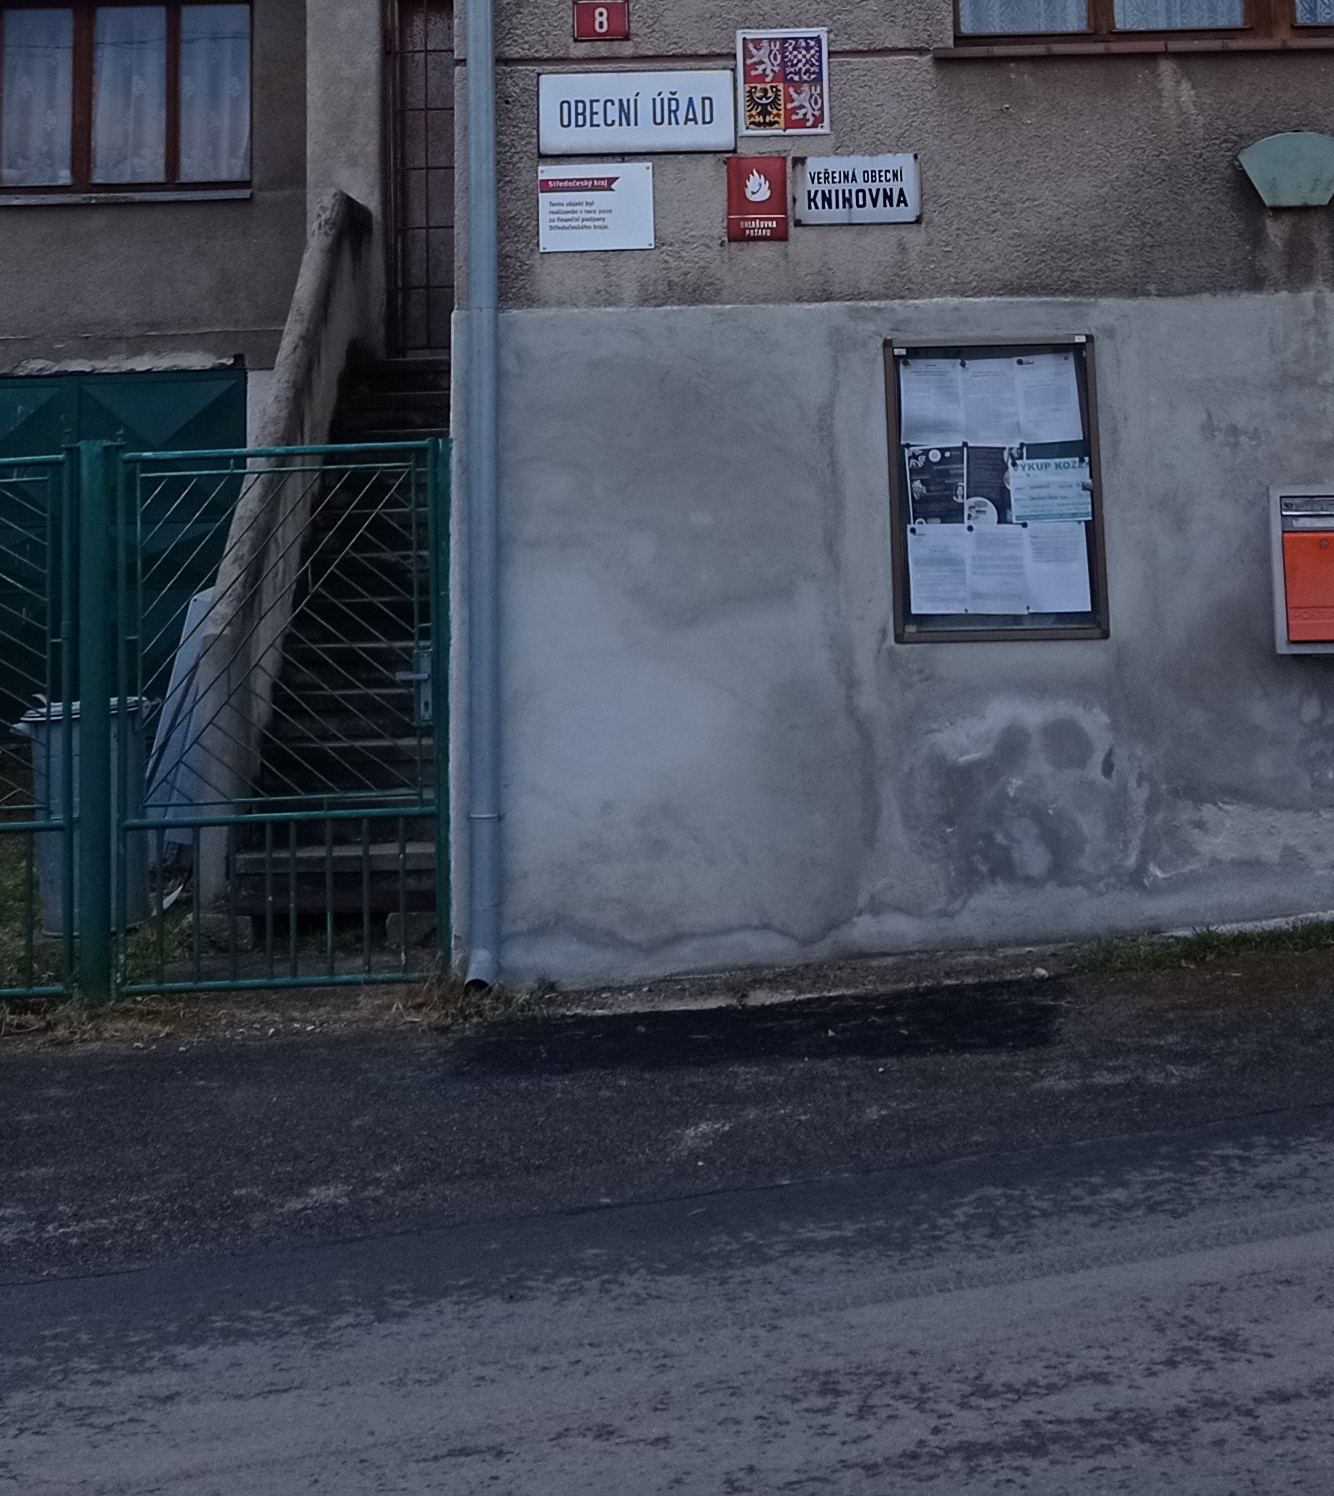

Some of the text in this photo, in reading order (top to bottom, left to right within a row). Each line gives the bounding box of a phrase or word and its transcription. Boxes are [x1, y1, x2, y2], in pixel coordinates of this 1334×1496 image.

[594, 7, 608, 33] 8
[559, 91, 714, 129] OBECNÍ ÚŘAD
[548, 179, 608, 188] Středočeský kraj
[809, 166, 903, 184] VEŘEJNÁ OBECNÍ
[807, 188, 908, 210] KNIHOVNA
